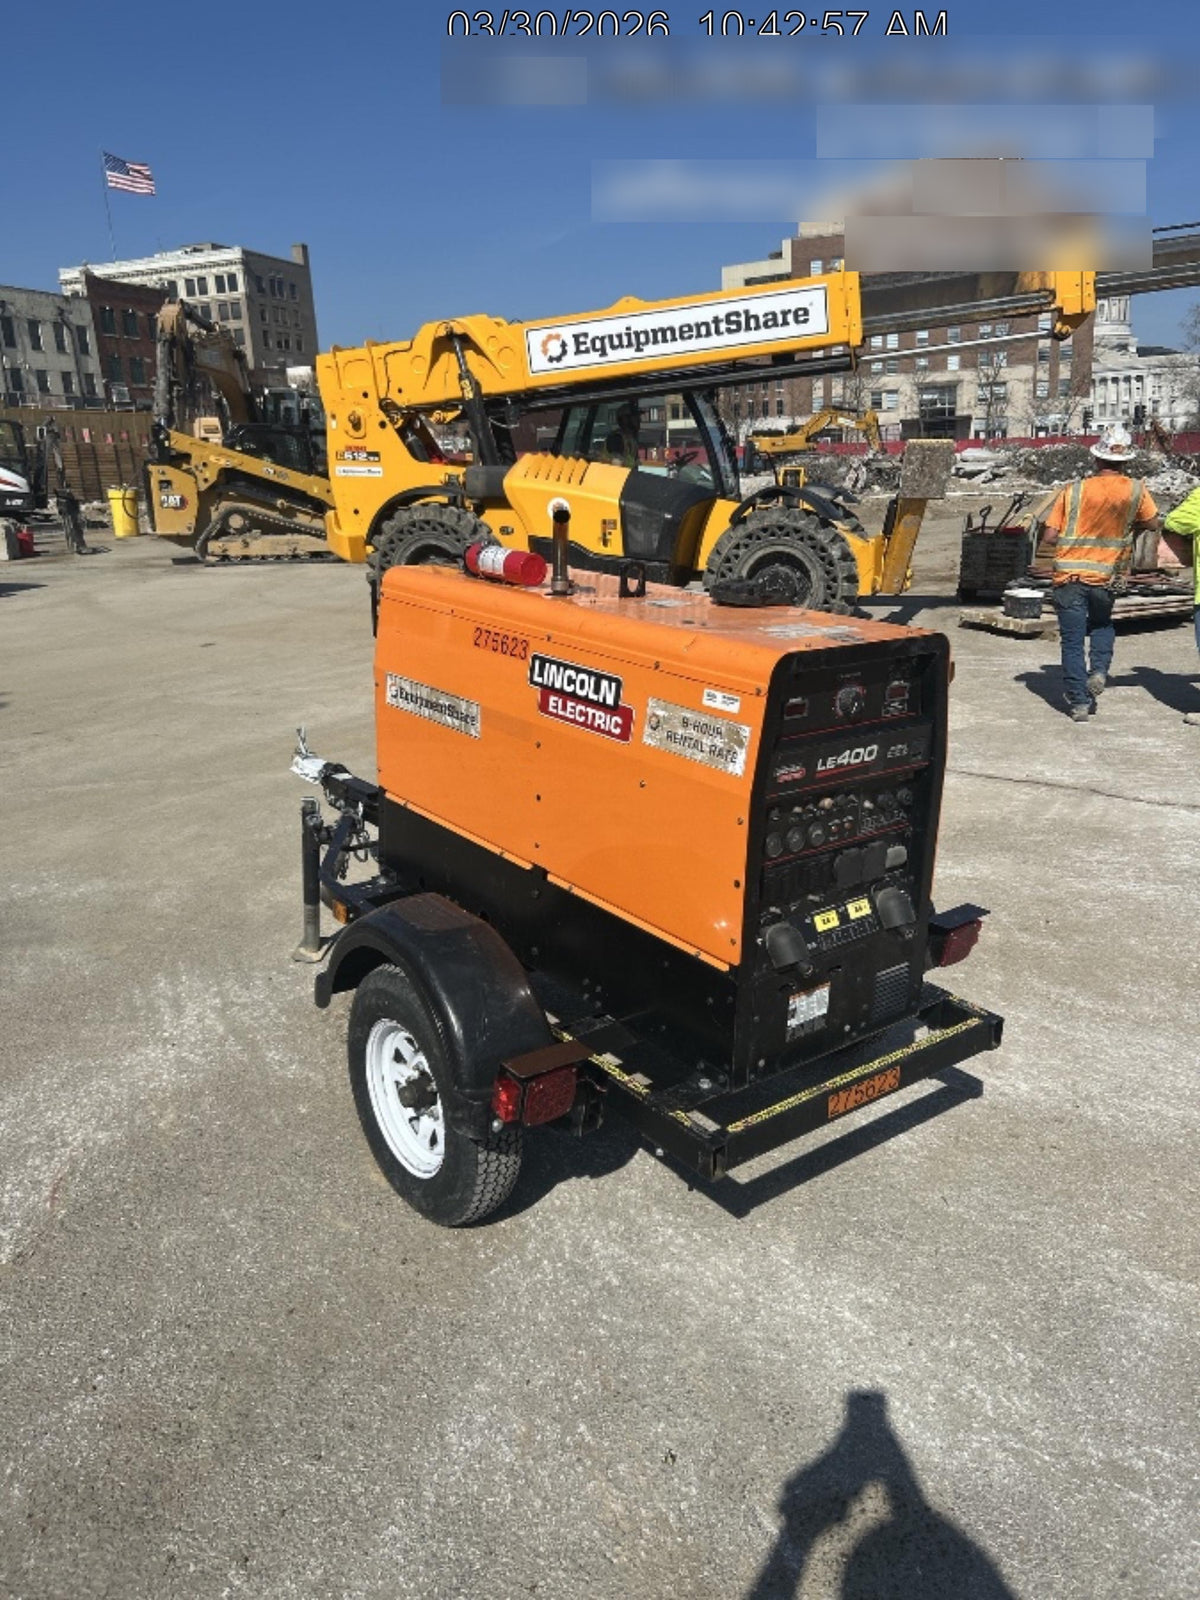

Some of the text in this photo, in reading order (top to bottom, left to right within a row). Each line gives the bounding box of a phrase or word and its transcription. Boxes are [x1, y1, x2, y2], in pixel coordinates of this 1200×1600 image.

[572, 305, 811, 358] EquipmentShare
[473, 627, 531, 660] 275623
[532, 658, 619, 707] LINCOLN
[547, 695, 624, 736] ELECTRIC
[681, 715, 723, 740] 8-HOUR
[665, 730, 739, 764] RENTAL RATE
[816, 744, 879, 771] LE400
